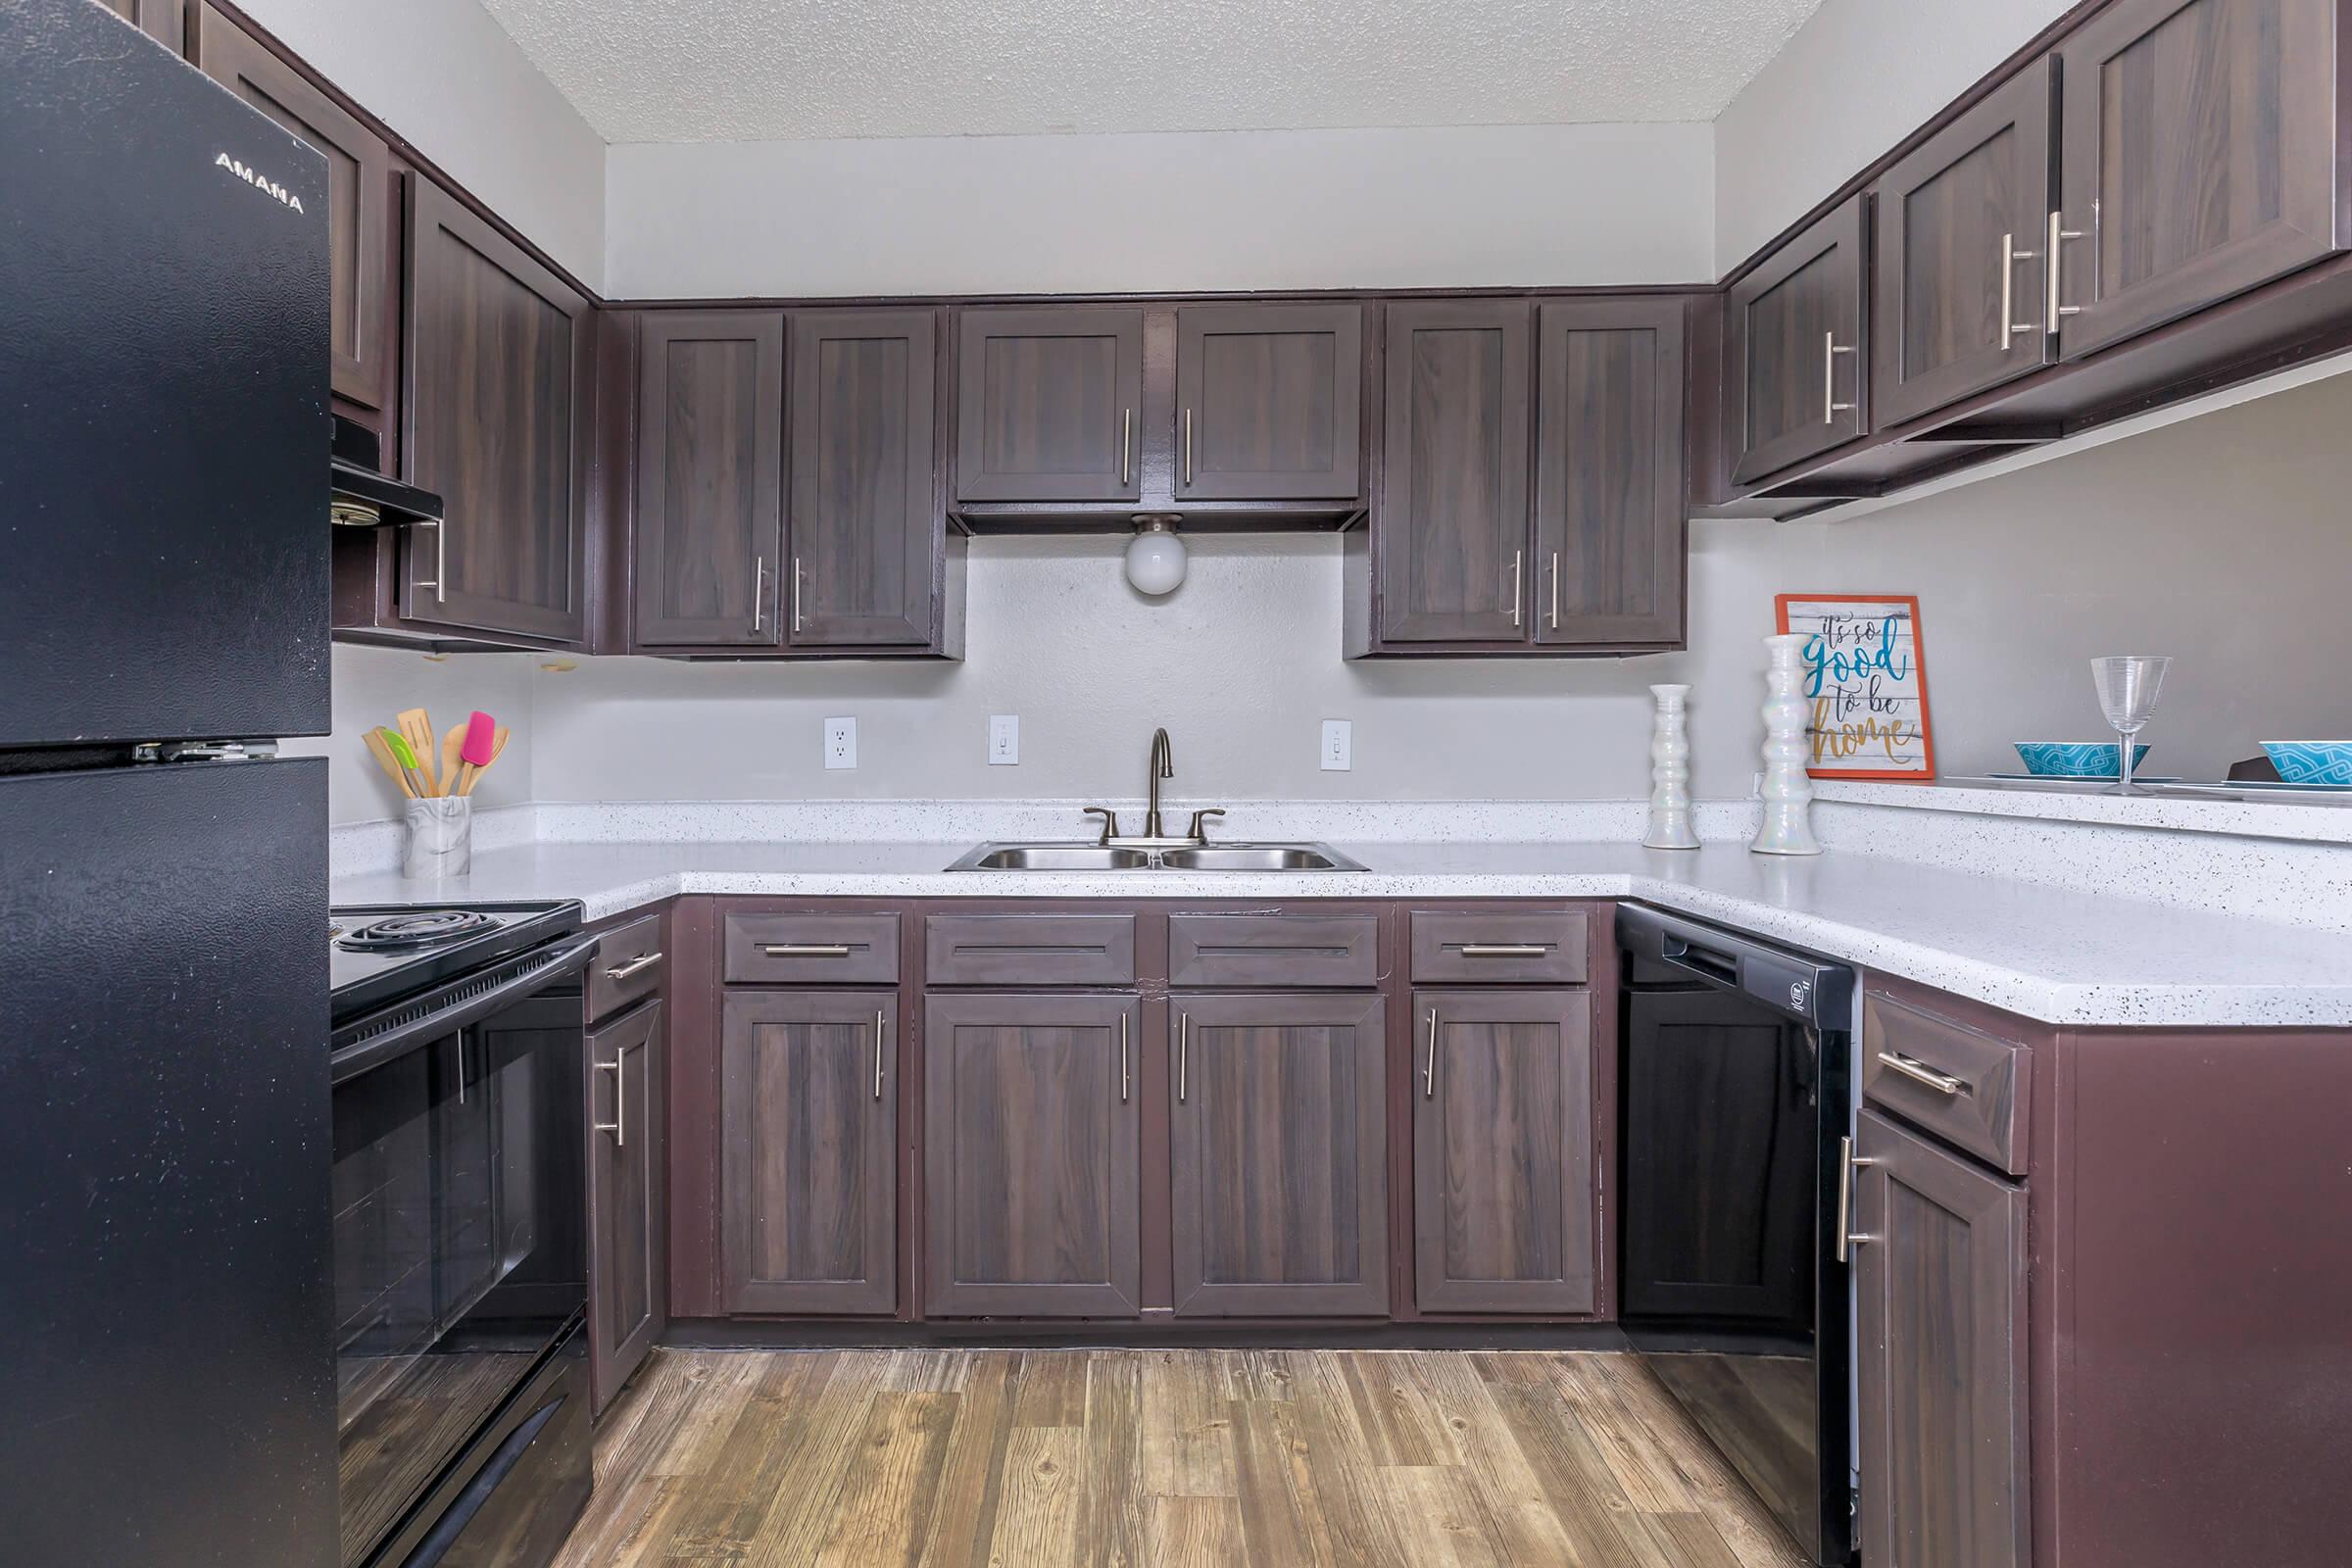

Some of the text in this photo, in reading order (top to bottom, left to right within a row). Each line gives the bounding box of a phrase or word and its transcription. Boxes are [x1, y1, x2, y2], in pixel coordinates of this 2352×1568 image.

[215, 152, 304, 215] AMANA
[1803, 616, 1906, 698] good
[1854, 621, 1881, 644] so
[1827, 674, 1900, 722] to be
[1814, 696, 1915, 764] home
